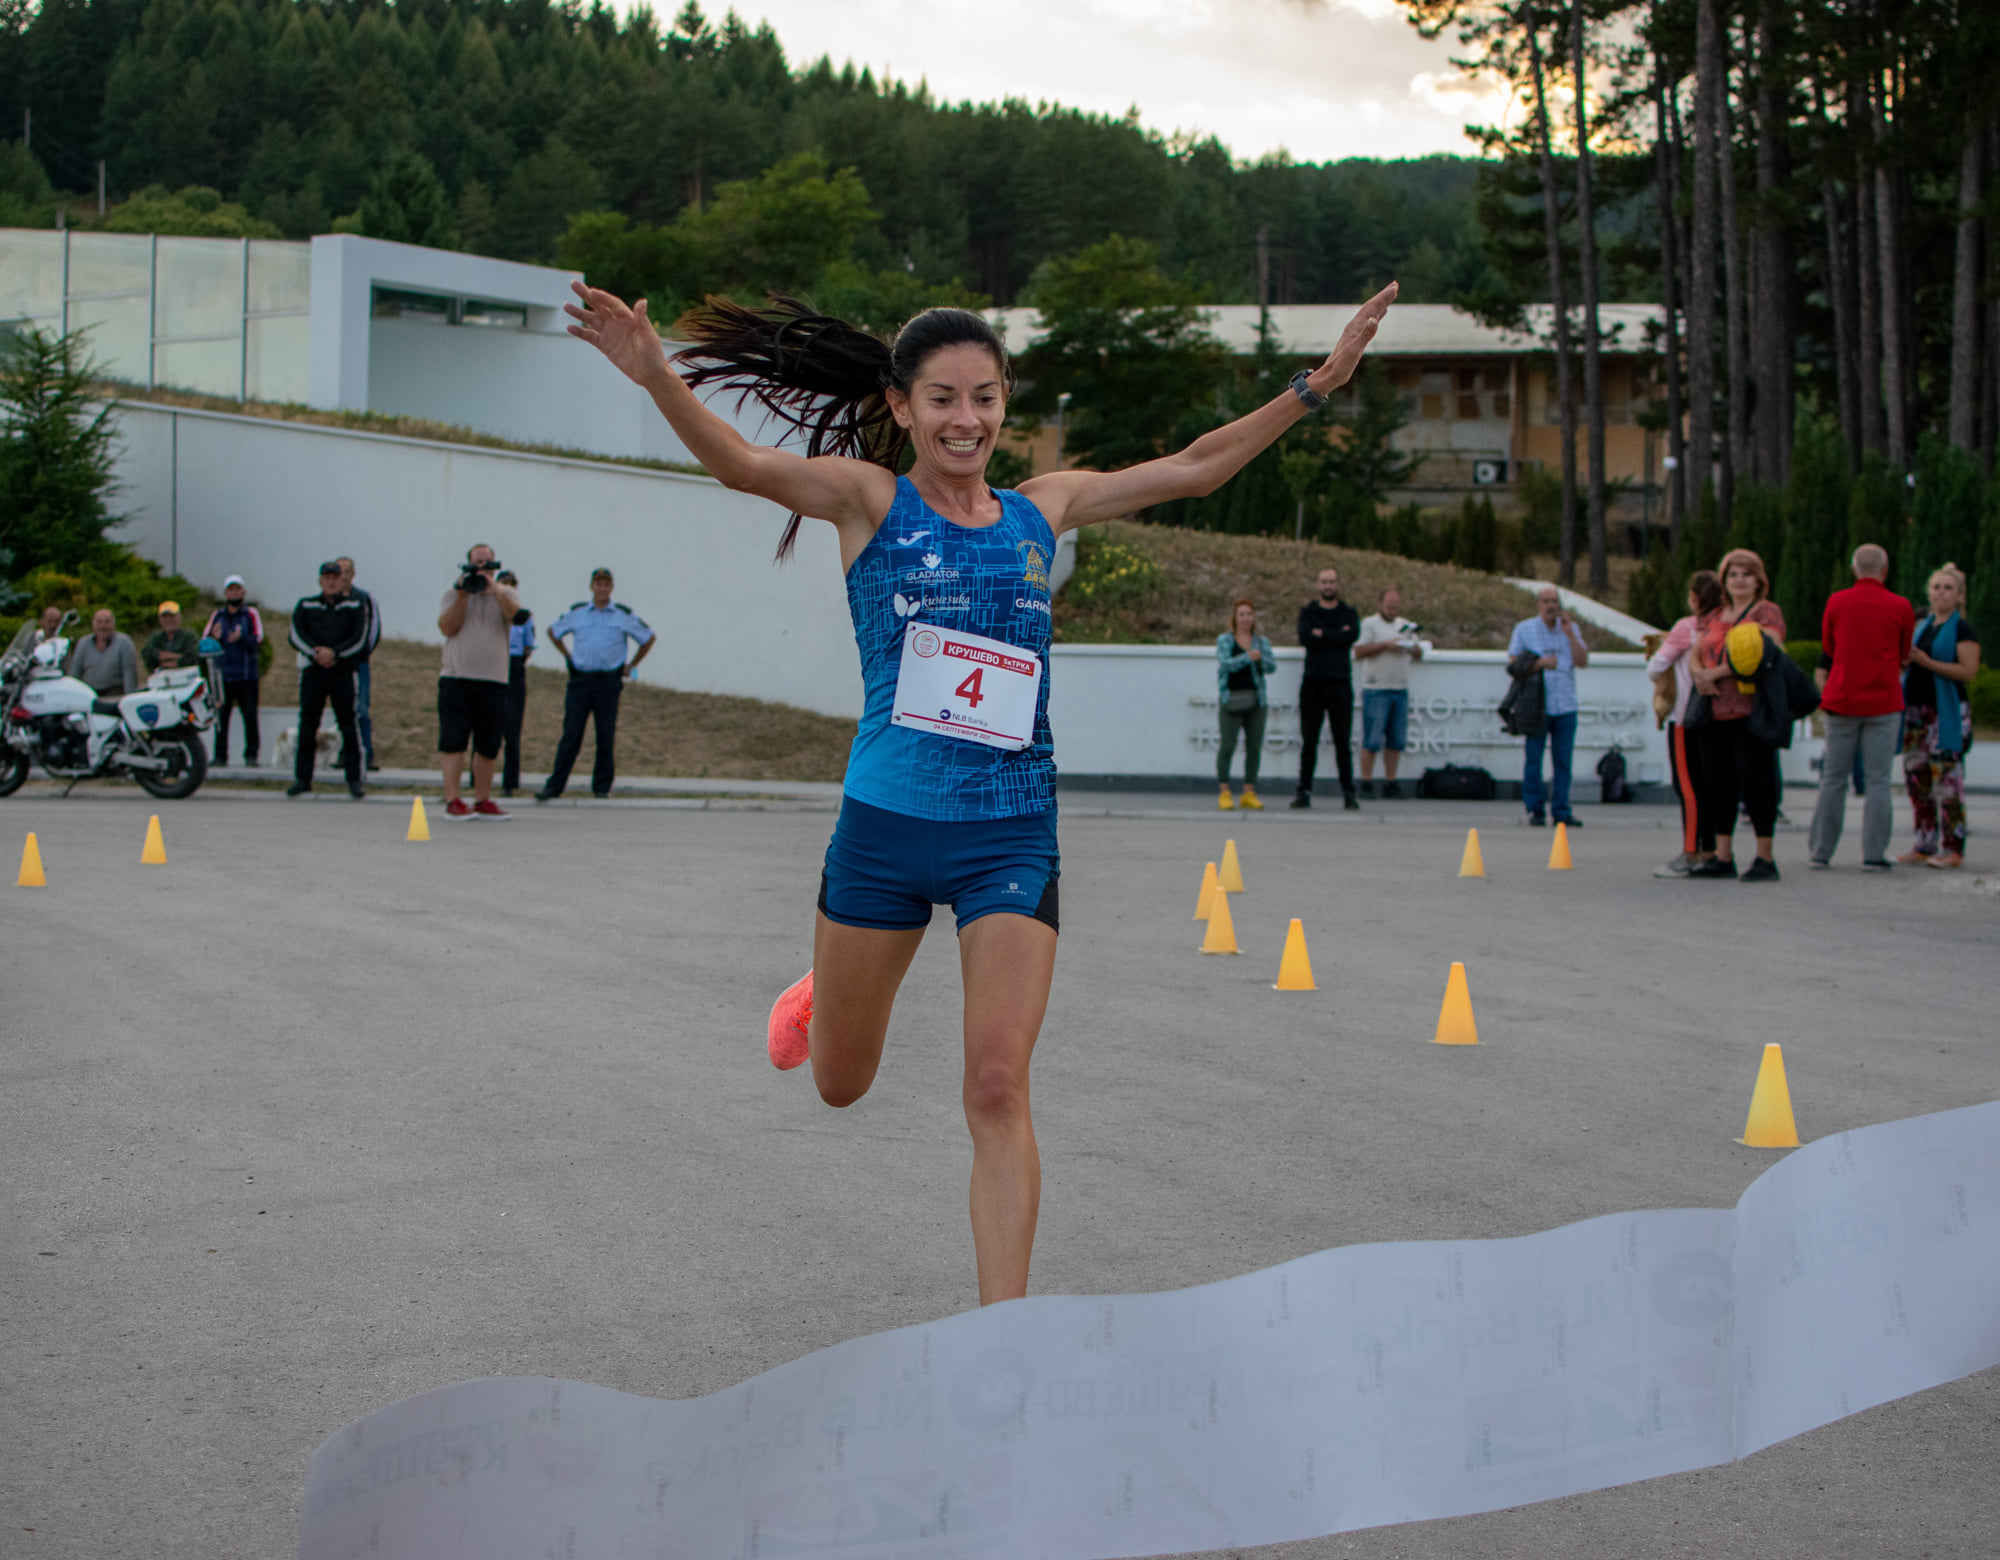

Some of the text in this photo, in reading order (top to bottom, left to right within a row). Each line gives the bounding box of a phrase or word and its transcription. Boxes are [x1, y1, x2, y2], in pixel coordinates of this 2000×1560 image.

[906, 570, 960, 581] GLADIATOR
[947, 644, 1000, 665] КРУШЕВО
[954, 667, 984, 708] 4
[952, 713, 967, 722] NLB
